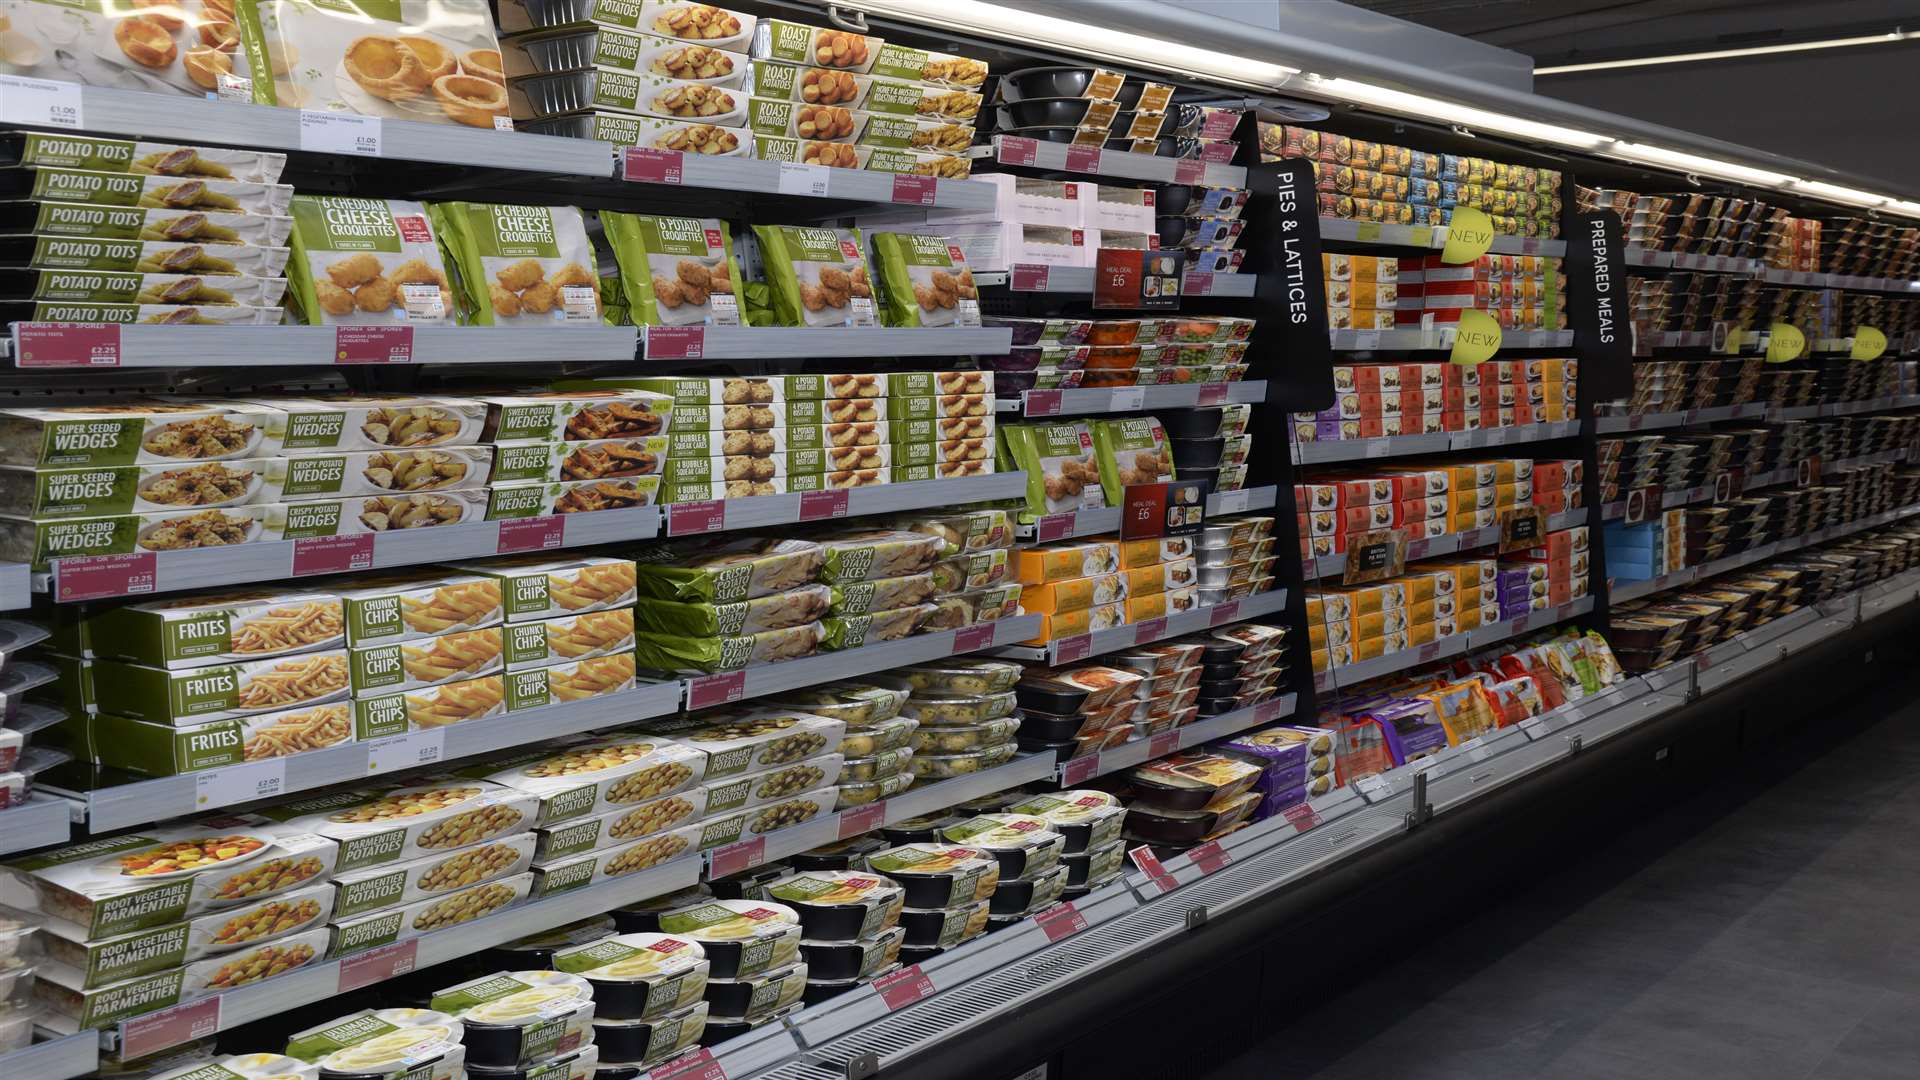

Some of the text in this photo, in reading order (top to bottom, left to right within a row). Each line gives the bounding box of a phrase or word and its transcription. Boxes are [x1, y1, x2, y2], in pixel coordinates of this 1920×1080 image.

[598, 1, 640, 18] POTATOES
[602, 32, 639, 47] ROASTING
[780, 24, 810, 40] ROAST
[600, 44, 637, 59] POTATOES
[778, 38, 807, 51] POTATOES
[764, 63, 795, 80] ROAST
[601, 72, 638, 87] ROASTING
[762, 78, 792, 90] POTATOES
[600, 84, 636, 99] POTATOES
[50, 106, 76, 114] £1.00
[600, 116, 638, 130] ROASTING
[599, 128, 637, 143] POTATOES
[38, 140, 130, 160] POTATO TOTS
[48, 174, 139, 193] POTATO TOTS
[322, 198, 385, 211] 6 CHEDDAR
[494, 206, 548, 218] 6 CHEDDAR
[51, 208, 140, 226] POTATO TOTS
[326, 209, 392, 226] CHEESE
[497, 217, 551, 232] CHEESE
[330, 224, 396, 237] CROQUETTES
[660, 218, 700, 233] 6 POTATO
[500, 232, 553, 243] CROQUETTES
[661, 229, 703, 243] CROQUETTES
[800, 230, 837, 242] 6 POTATO
[1450, 229, 1490, 245] NEW
[802, 240, 838, 252] CROQUETTES
[1278, 172, 1306, 324] PIES & LATTICES
[50, 276, 138, 291] POTATO TOTS
[1112, 275, 1125, 286] £6
[1591, 220, 1614, 343] PREPARED MEALS
[46, 308, 134, 322] POTATO TOTS
[1457, 333, 1498, 346] NEW
[1770, 338, 1803, 350] NEW
[1855, 340, 1886, 350] NEW
[682, 381, 701, 390] BUBBLE
[295, 414, 343, 424] CRISPY POTATO
[507, 406, 552, 418] SWEET POTATO
[56, 423, 121, 434] SUPER SEEDED
[293, 421, 340, 436] WEDGES
[506, 415, 549, 429] WEDGES
[1054, 426, 1075, 438] POTATO
[55, 433, 118, 450] WEDGES
[503, 447, 548, 459] SWEET POTATO
[502, 456, 545, 470] WEDGES
[49, 473, 116, 485] SUPER SEEDED
[49, 482, 113, 501] WEDGES
[498, 488, 542, 499] SWEET POTATO
[290, 504, 339, 516] CRISPY POTATO
[496, 495, 538, 510] WEDGES
[288, 513, 337, 528] WEDGES
[1138, 508, 1149, 519] £6
[48, 522, 115, 535] SUPER SEEDED
[48, 531, 113, 550] WEDGES
[719, 565, 753, 581] CRISPY
[516, 576, 546, 588] CHUNKY
[717, 577, 749, 590] POTATO
[518, 586, 547, 600] CHIPS
[716, 589, 746, 600] SLICES
[364, 599, 398, 612] CHUNKY
[366, 609, 399, 624] CHIPS
[179, 619, 226, 640] FRITES
[722, 636, 754, 649] CRISPY
[366, 648, 399, 661] CHUNKY
[367, 659, 400, 674] CHIPS
[186, 675, 234, 696] FRITES
[516, 671, 546, 685] CHUNKY
[518, 681, 547, 696] CHIPS
[369, 696, 402, 710] CHUNKY
[370, 709, 404, 724] CHIPS
[191, 730, 238, 751] FRITES
[712, 748, 752, 763] ROSEMARY
[711, 756, 749, 772] POTATOES
[258, 778, 280, 787] £2.00
[552, 787, 595, 807] PARMENTIER
[550, 797, 595, 816] POTATOES
[705, 818, 743, 834] ROSEMARY
[348, 829, 405, 851] PARMENTIER
[702, 826, 741, 842] POTATOES
[345, 841, 402, 862] POTATOES
[350, 873, 404, 893] PARMENTIER
[104, 884, 189, 912] ROOT VEGETABLE
[346, 884, 403, 906] POTATOES
[101, 894, 186, 924] PARMENTIER
[346, 914, 400, 935] PARMENTIER
[100, 928, 185, 958] ROOT VEGETABLE
[343, 925, 398, 946] POTATOES
[99, 939, 183, 971] PARMENTIER
[95, 973, 179, 1005] ROOT VEGETABLE
[92, 984, 177, 1018] PARMENTIER
[323, 1014, 374, 1038] ULTIMATE
[529, 1023, 566, 1042] ULTIMATE
